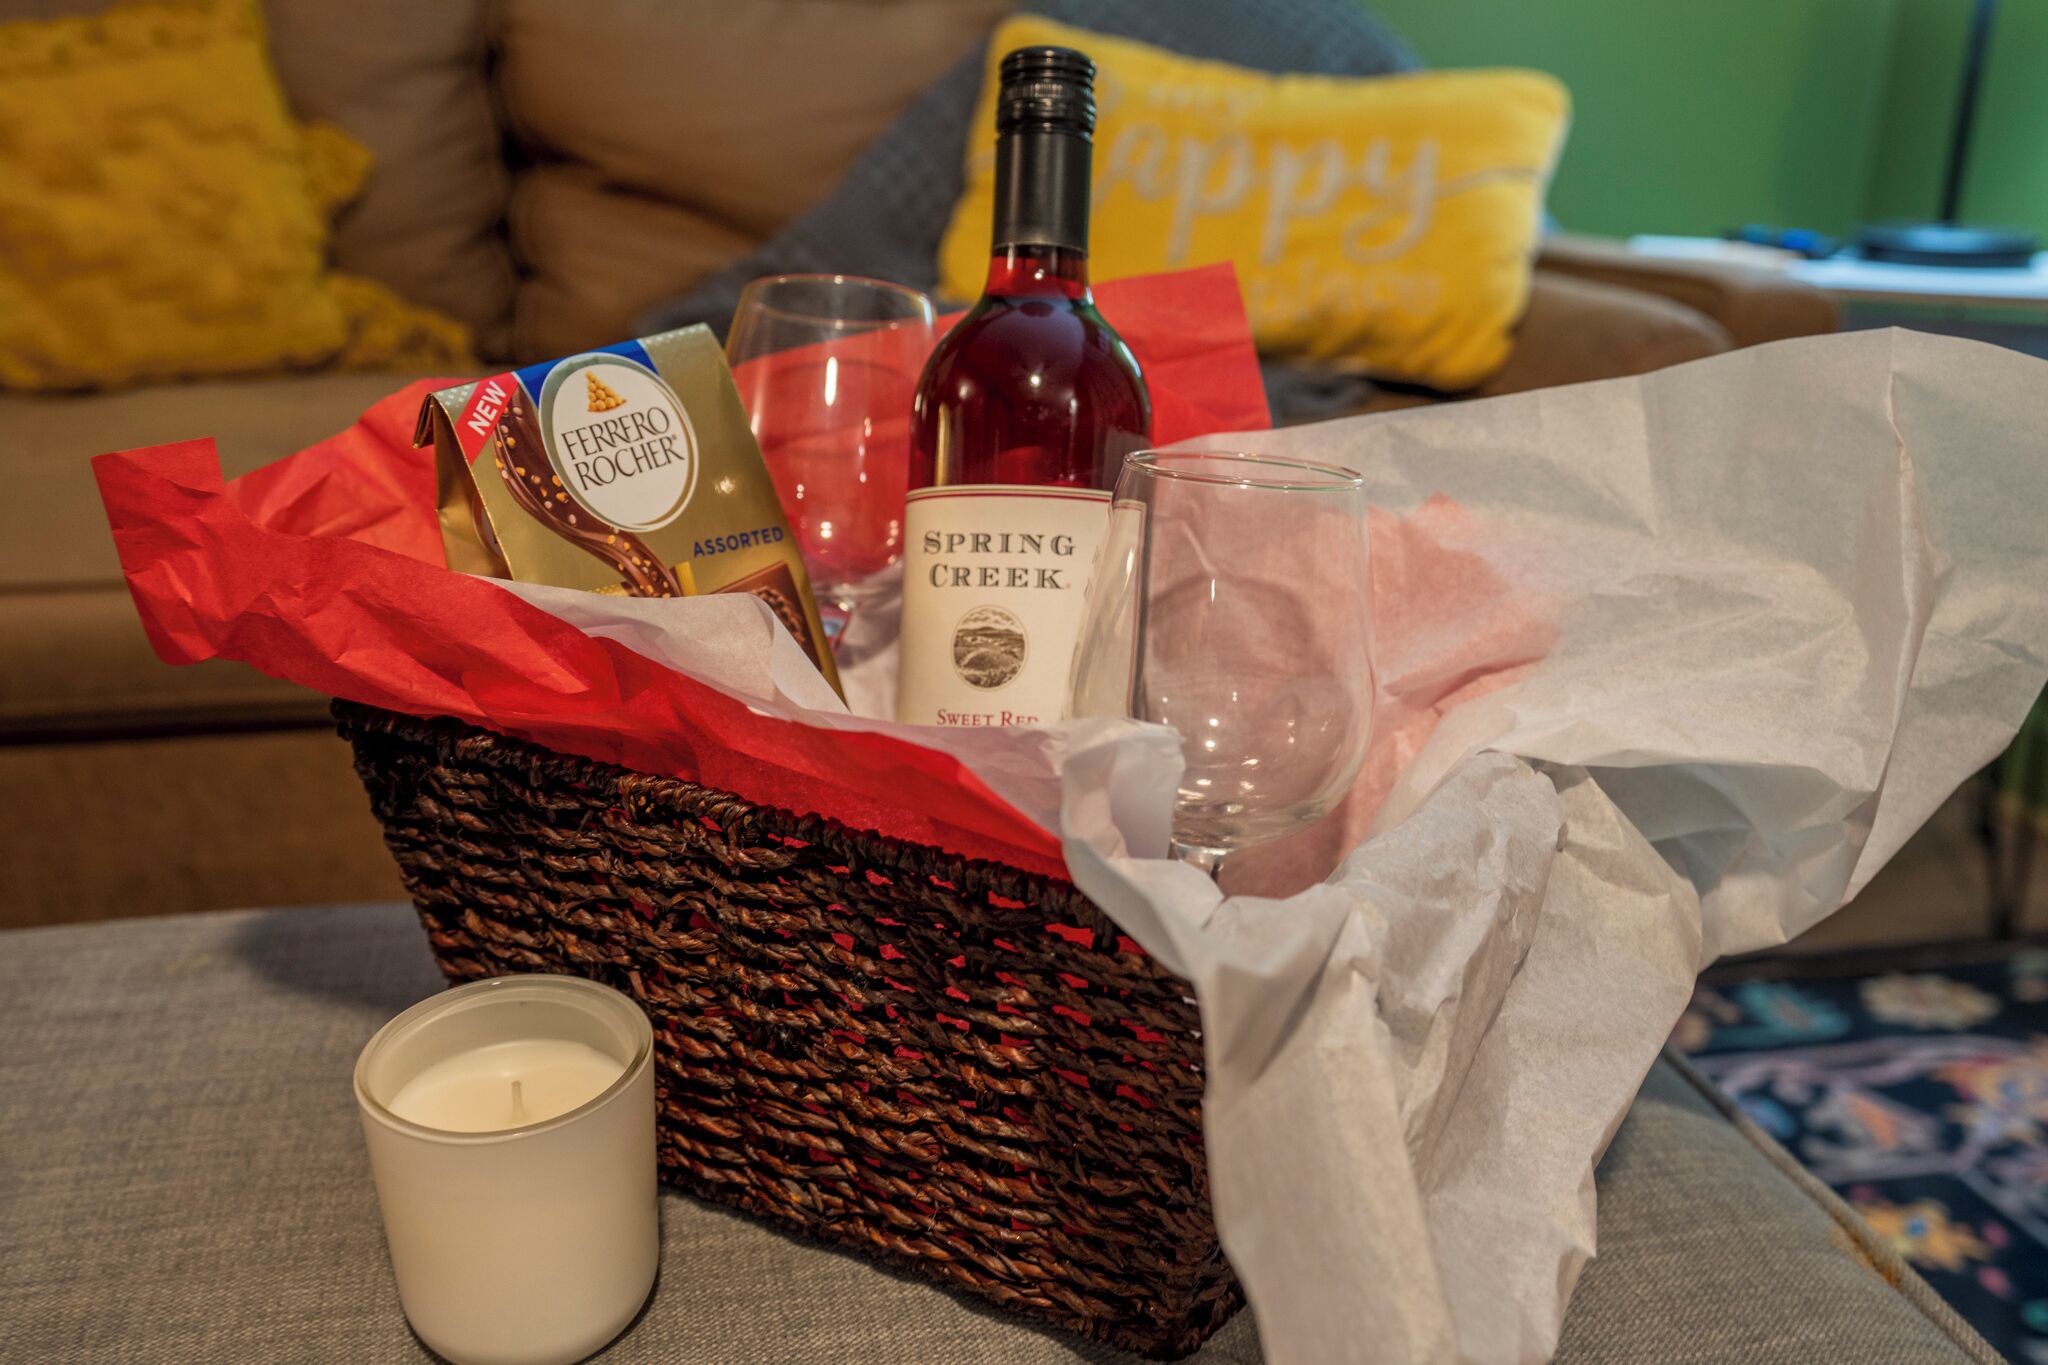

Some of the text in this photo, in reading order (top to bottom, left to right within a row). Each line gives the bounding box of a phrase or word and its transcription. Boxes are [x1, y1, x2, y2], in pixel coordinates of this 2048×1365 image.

[1098, 120, 1444, 268] appy
[467, 380, 507, 436] NEW
[561, 406, 670, 460] FERRERO
[574, 436, 685, 491] ROCHER
[694, 526, 784, 558] ASSORTED
[923, 530, 1076, 556] SPRING
[929, 562, 1065, 590] CREEK
